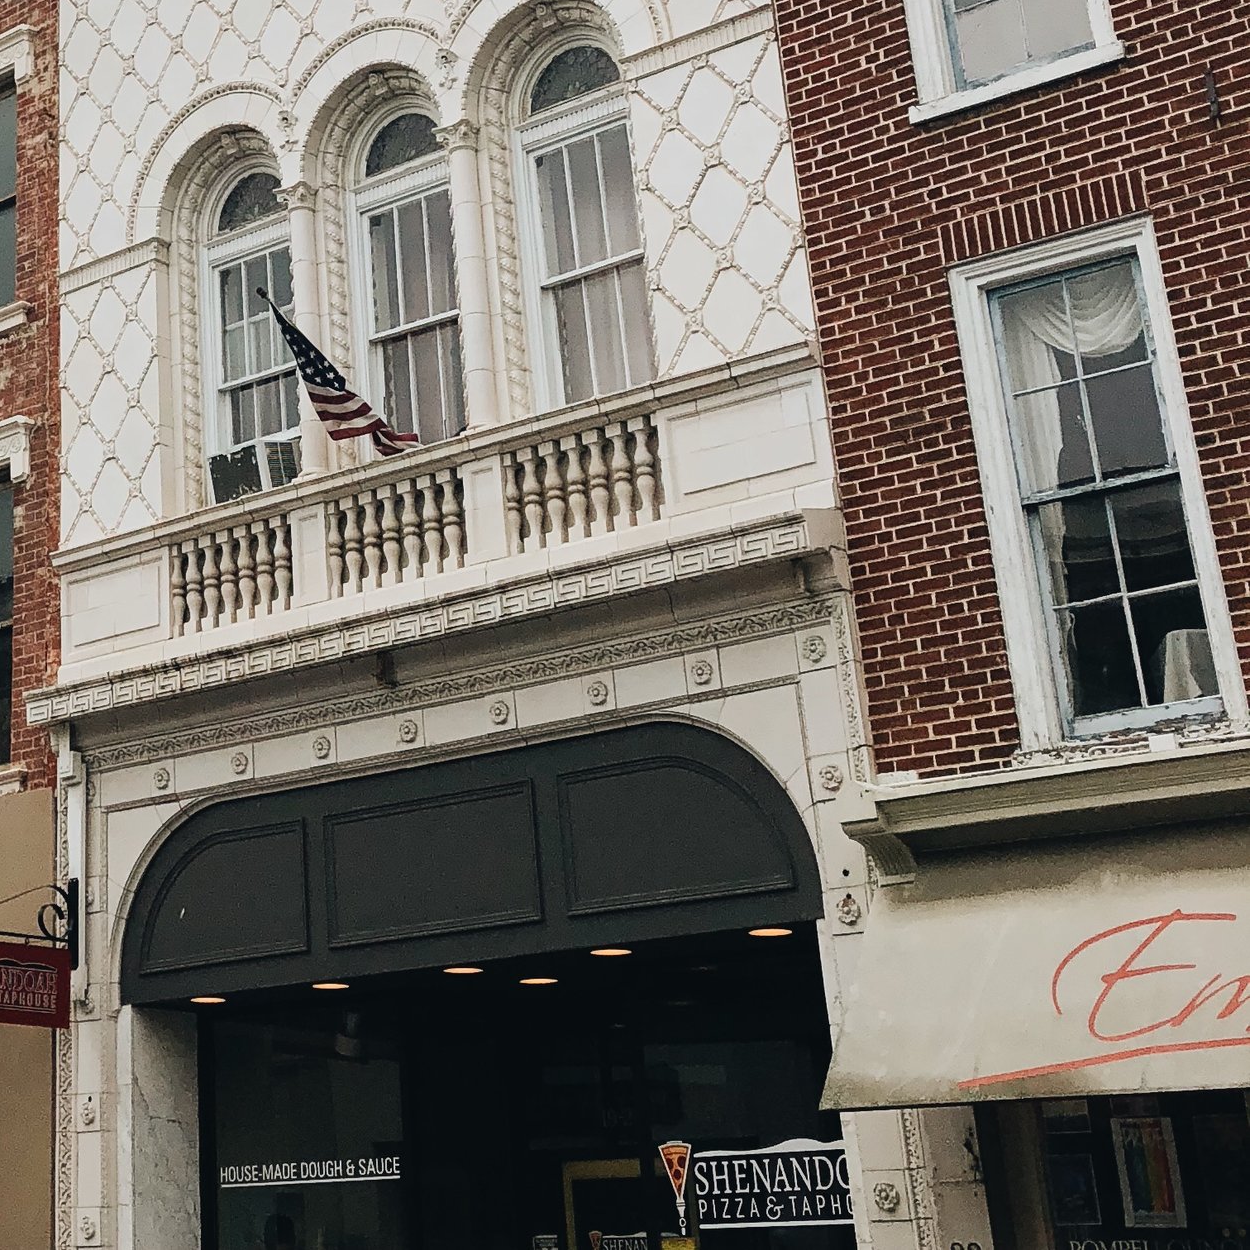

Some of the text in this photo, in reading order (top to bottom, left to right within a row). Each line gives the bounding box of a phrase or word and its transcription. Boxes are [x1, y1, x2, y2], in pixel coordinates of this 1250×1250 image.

[220, 1156, 400, 1183] HOUSE-MADE DOUGH & SAUCE
[699, 1197, 760, 1219] PIZZA
[765, 1196, 784, 1220] &
